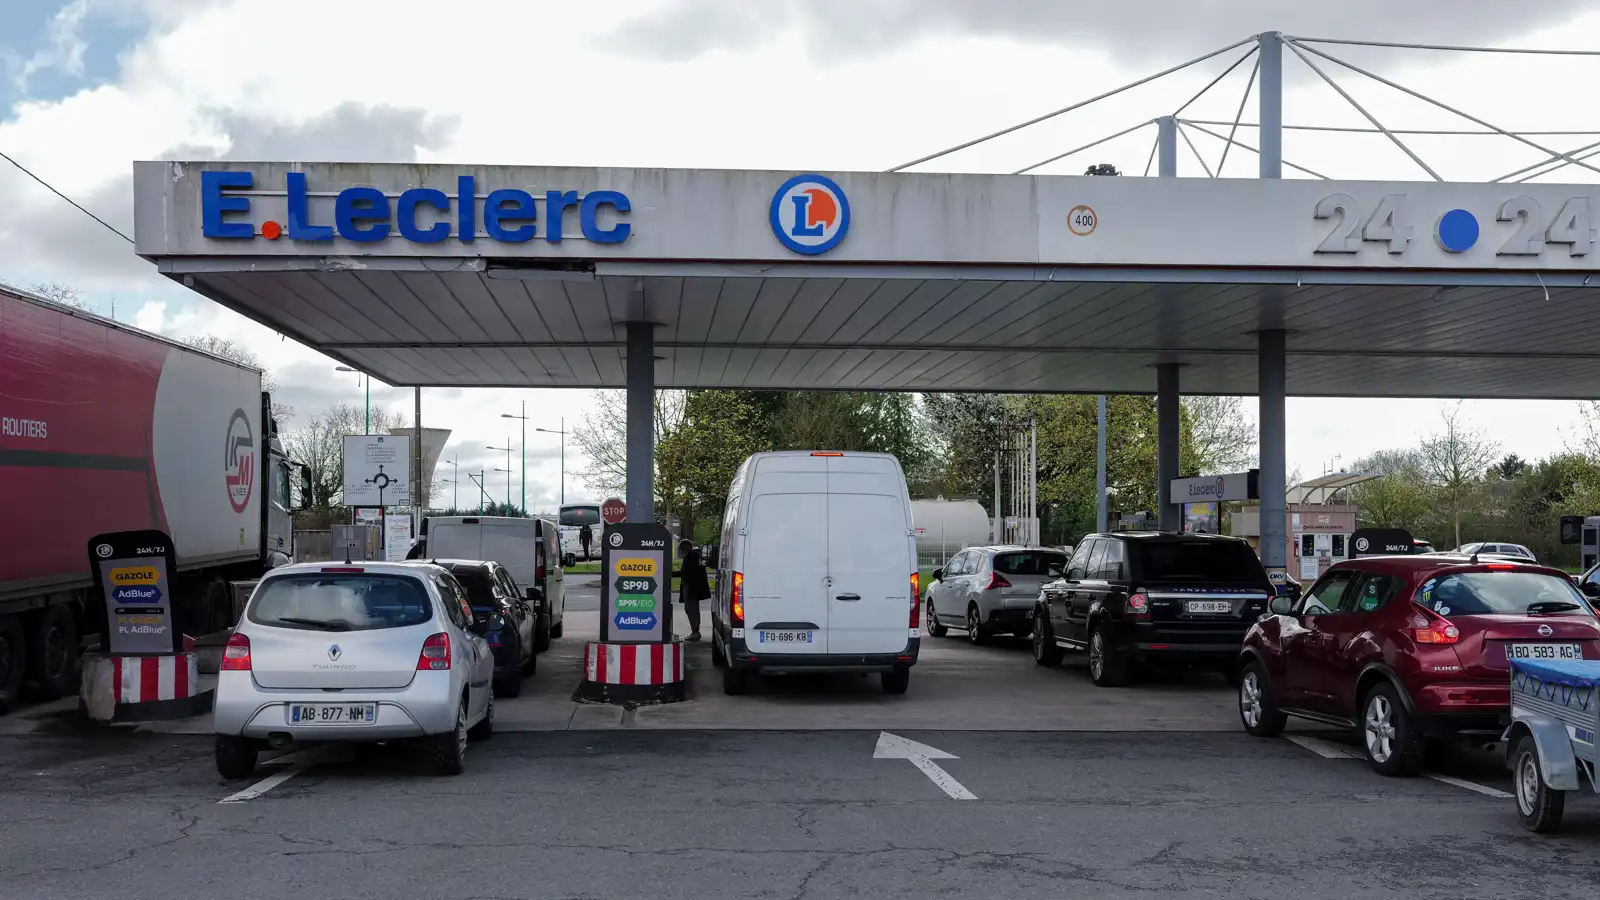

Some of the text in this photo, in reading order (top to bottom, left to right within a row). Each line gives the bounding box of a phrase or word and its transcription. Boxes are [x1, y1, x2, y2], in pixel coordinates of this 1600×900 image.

[201, 171, 631, 244] E.Leclerc
[1313, 193, 1598, 257] 24 24
[2, 416, 48, 439] ROUTIERS
[1189, 484, 1216, 497] E.Leclerc
[604, 507, 625, 516] STOP
[136, 546, 165, 554] 24H/7J
[620, 563, 653, 572] GAZOLE
[115, 571, 154, 581] GAZOLE
[622, 580, 649, 590] SP98
[618, 599, 654, 607] SP95/E10
